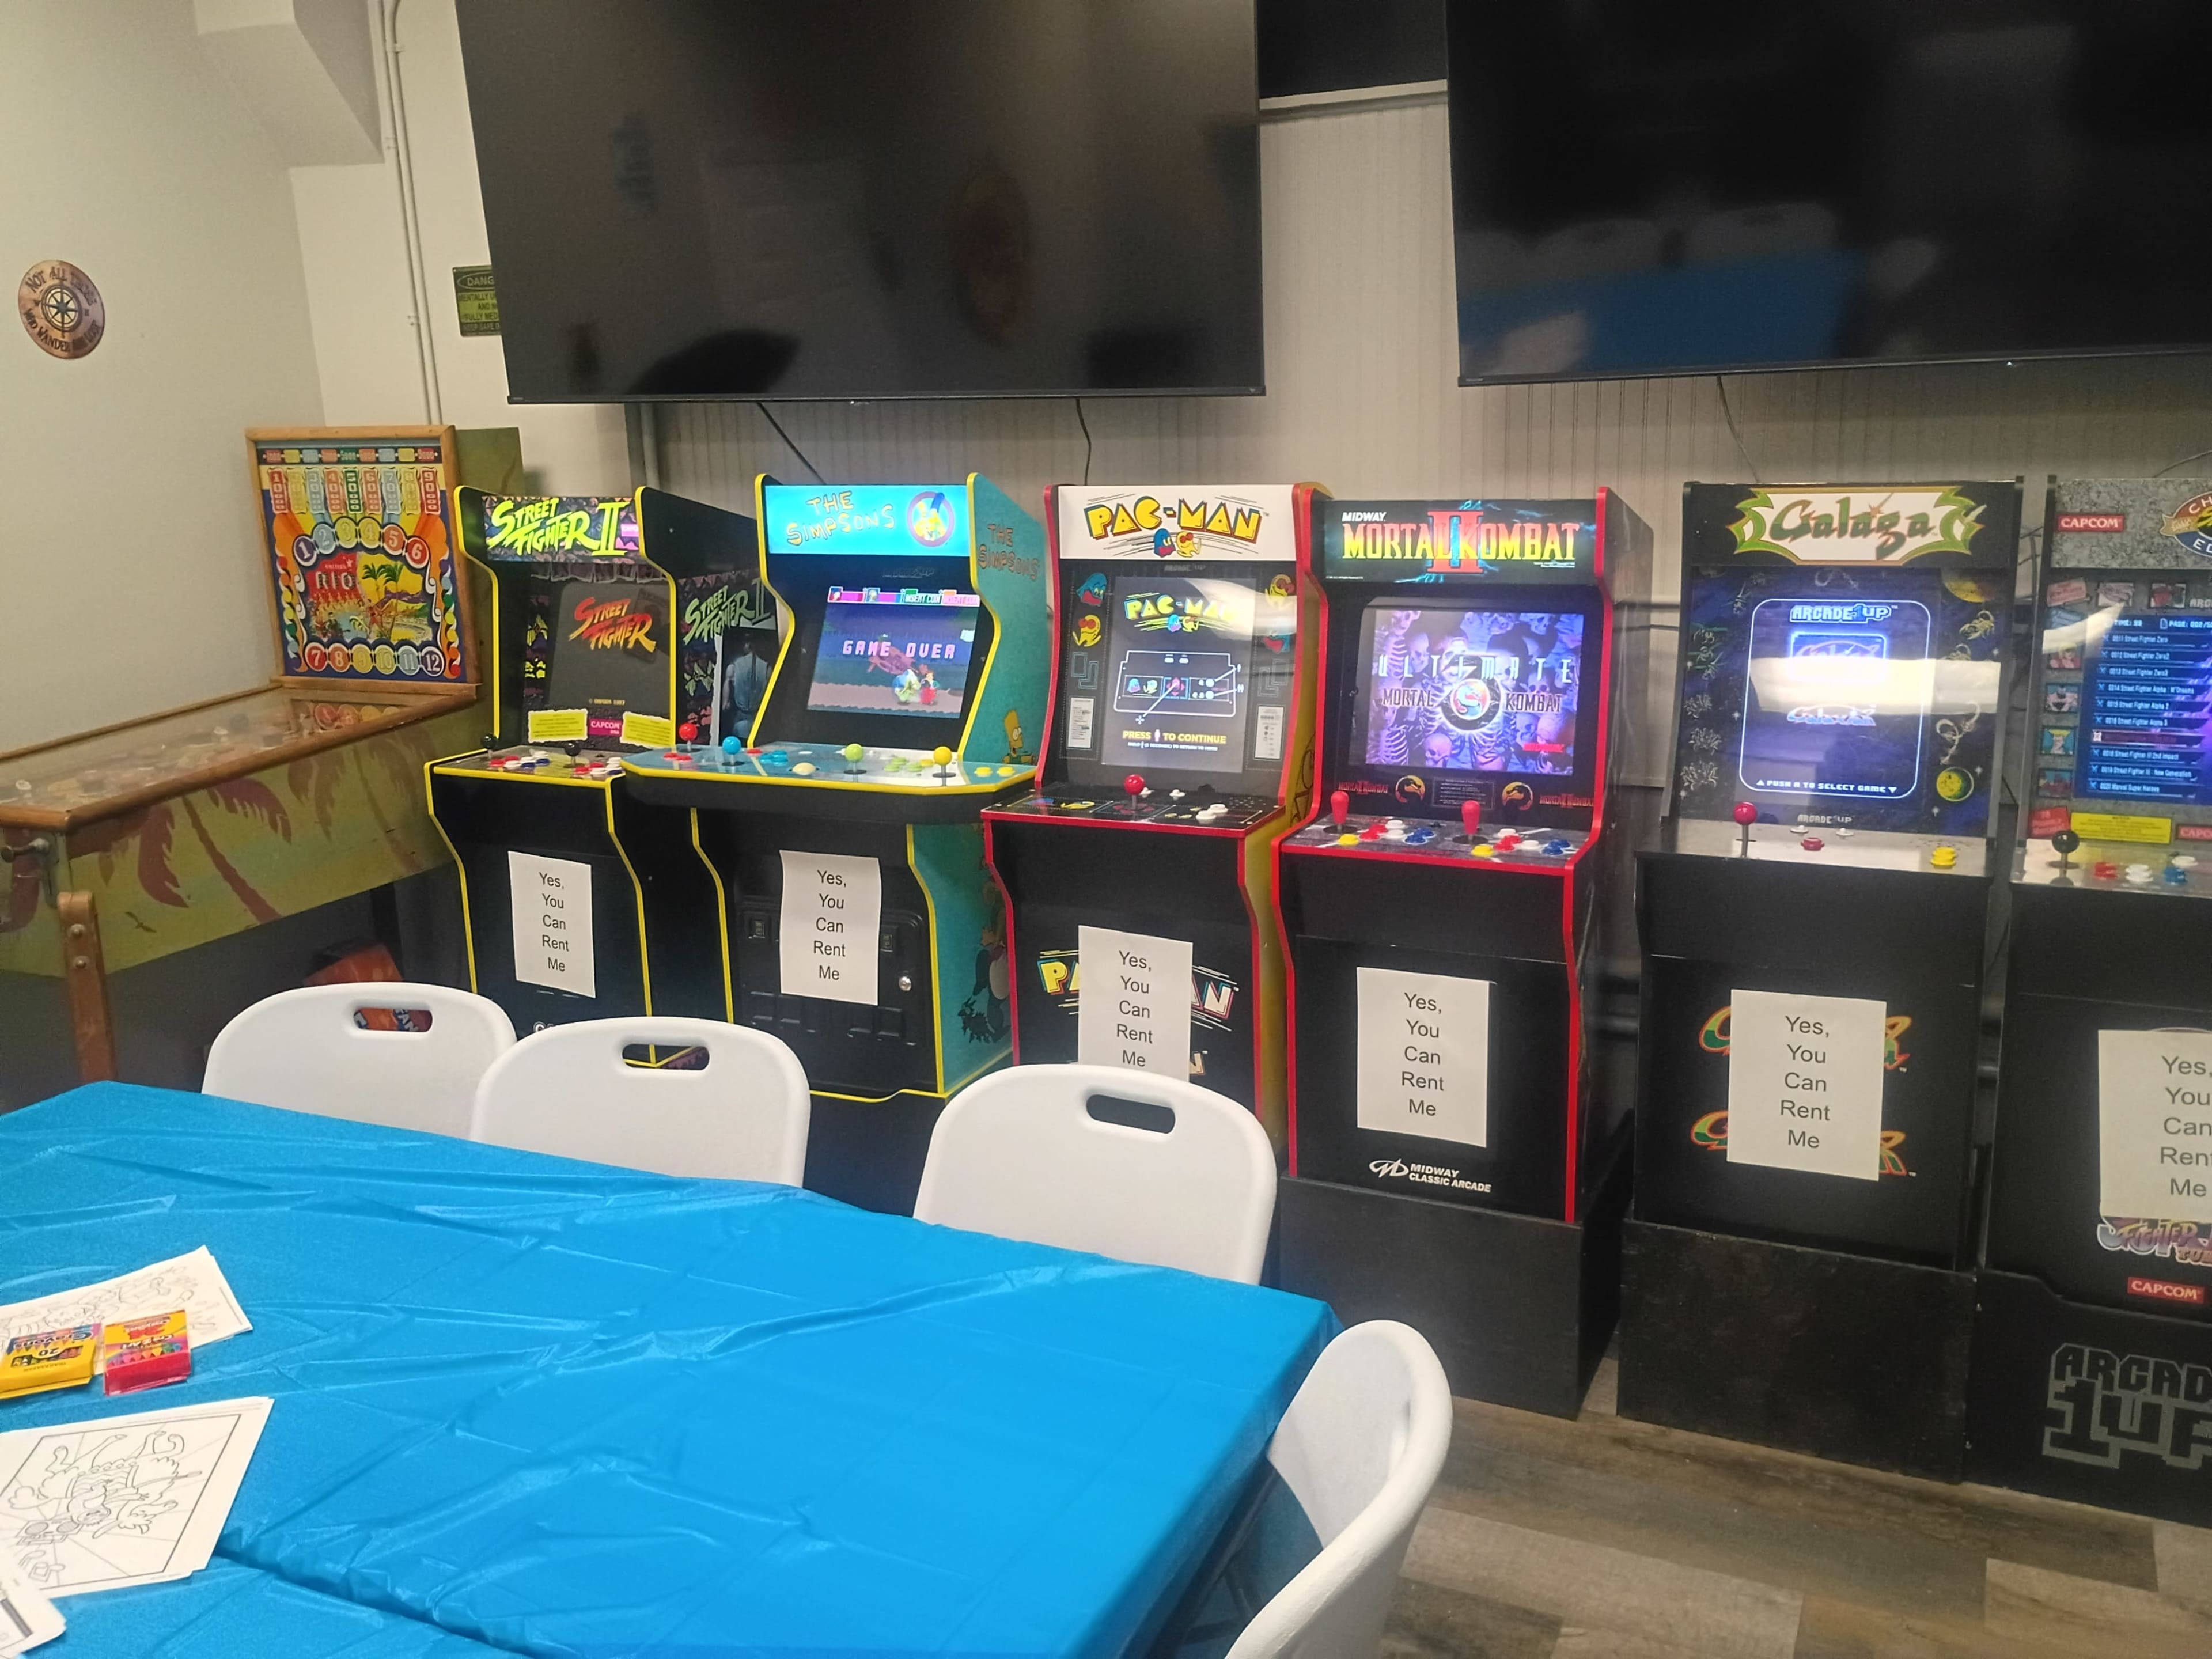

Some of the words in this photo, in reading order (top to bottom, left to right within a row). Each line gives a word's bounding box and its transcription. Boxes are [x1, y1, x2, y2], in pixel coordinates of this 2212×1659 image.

[25, 271, 47, 293] NOT
[467, 276, 494, 286] DANG
[806, 490, 854, 515] THE
[486, 497, 559, 549] STREET
[786, 504, 895, 546] SIMPSONS
[1084, 496, 1262, 543] PAC-MAN
[1342, 512, 1387, 521] MIDWAY
[2060, 518, 2119, 528] CAPCOM
[318, 529, 330, 546] 2
[340, 522, 351, 541] 3
[366, 522, 375, 541] 4
[502, 510, 601, 556] FIGHTER
[592, 501, 630, 556] II
[987, 524, 1014, 547] THE
[1769, 497, 1936, 561] Galaga
[389, 530, 399, 547] 5
[1342, 523, 1452, 559] MORTAL
[1459, 523, 1580, 560] KOMBAT
[298, 542, 311, 559] 1
[412, 543, 422, 560] 6
[316, 571, 355, 590] RIO
[568, 597, 631, 641] STREET
[683, 585, 728, 645] STREET
[695, 589, 756, 642] FIGHTER
[581, 613, 657, 653] FIGHTER
[312, 650, 321, 666] 7
[334, 650, 344, 667] 8
[843, 640, 891, 657] GAME
[906, 642, 955, 659] OVER
[358, 652, 366, 668] 9
[380, 652, 392, 669] 10
[403, 653, 415, 670] 11
[425, 654, 440, 672] 12
[1378, 654, 1573, 683] ULTIMATE
[1382, 688, 1434, 707] MORTAL
[1506, 692, 1563, 712] KOMBAT
[590, 721, 620, 729] CAPCOM
[1123, 730, 1151, 740] PRESS
[1162, 733, 1176, 741] TO
[1178, 734, 1226, 744] CONTINUE
[1818, 783, 1855, 791] SELECT
[1858, 785, 1886, 793] GAME
[539, 872, 565, 889] Yes,
[817, 870, 847, 888] Yes,
[542, 893, 564, 909] You
[819, 893, 844, 910] You
[543, 915, 566, 930] Can
[816, 917, 844, 933] Can
[542, 934, 569, 952] Rent
[813, 941, 846, 957] Rent
[548, 957, 565, 972] Me
[1119, 950, 1152, 972] Yes,
[819, 965, 840, 980] Me
[1120, 976, 1150, 994] You
[1119, 1000, 1150, 1019] Can
[1404, 992, 1441, 1014] Yes,
[1116, 1024, 1153, 1044] Rent
[1406, 1019, 1440, 1038] You
[1785, 1016, 1830, 1037] Yes,
[1122, 1050, 1146, 1067] Me
[1404, 1046, 1441, 1065] Can
[1787, 1044, 1826, 1064] You
[1402, 1071, 1444, 1091] Rent
[1785, 1073, 1827, 1092] Can
[2165, 1087, 2210, 1106] You
[1409, 1099, 1436, 1116] Me
[1781, 1100, 1830, 1121] Rent
[2163, 1117, 2212, 1137] Can
[1788, 1130, 1820, 1149] Me
[1410, 1164, 1459, 1177] MIDWAY
[1408, 1173, 1450, 1185] CLASSIC
[1451, 1179, 1492, 1193] ARCADE
[2170, 1178, 2207, 1197] Me
[2132, 1281, 2198, 1300] CAPCOM
[13, 1331, 93, 1348] Crayons
[38, 1347, 59, 1357] 20
